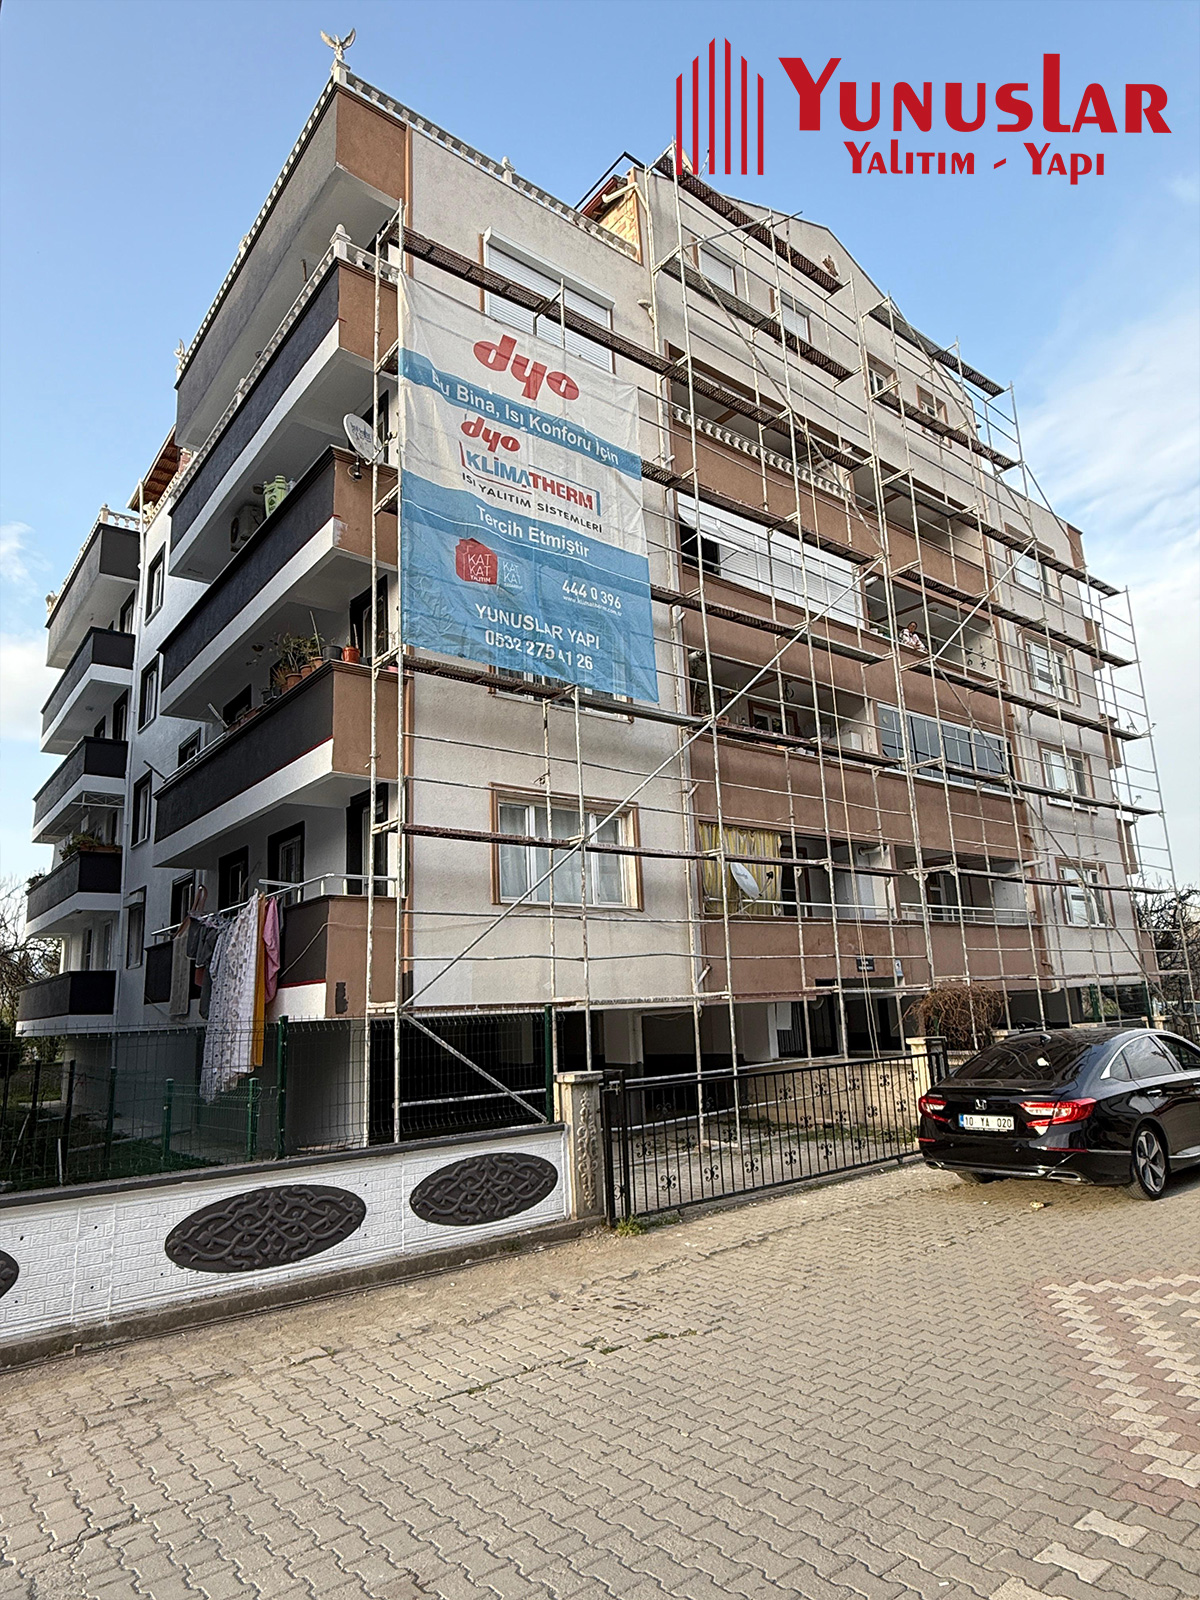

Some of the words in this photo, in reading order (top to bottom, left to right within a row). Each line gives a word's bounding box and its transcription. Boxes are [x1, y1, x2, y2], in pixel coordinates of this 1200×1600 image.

[473, 334, 580, 401] dyo
[431, 368, 450, 397] Bu
[456, 384, 500, 418] Bina,
[529, 413, 591, 452] Konforu
[595, 438, 619, 465] İçin
[460, 416, 521, 453] dyo
[462, 472, 476, 487] ISI
[478, 484, 532, 509] YALITIM
[537, 502, 602, 533] SİSTEMLERİ
[476, 504, 523, 538] Tercih
[528, 526, 590, 558] Etmiştir
[468, 553, 492, 566] KAT
[470, 565, 491, 577] KAT
[502, 560, 520, 573] KAT
[562, 579, 588, 598] 444
[590, 586, 598, 601] 0
[600, 590, 622, 609] 396
[475, 603, 564, 641] YUNUSLAR
[567, 627, 600, 650] YAPI
[485, 629, 523, 653] 0532
[525, 640, 555, 660] 275
[576, 653, 593, 670] 26
[965, 1116, 974, 1127] 10
[981, 1117, 990, 1127] YA
[996, 1117, 1013, 1129] 020
